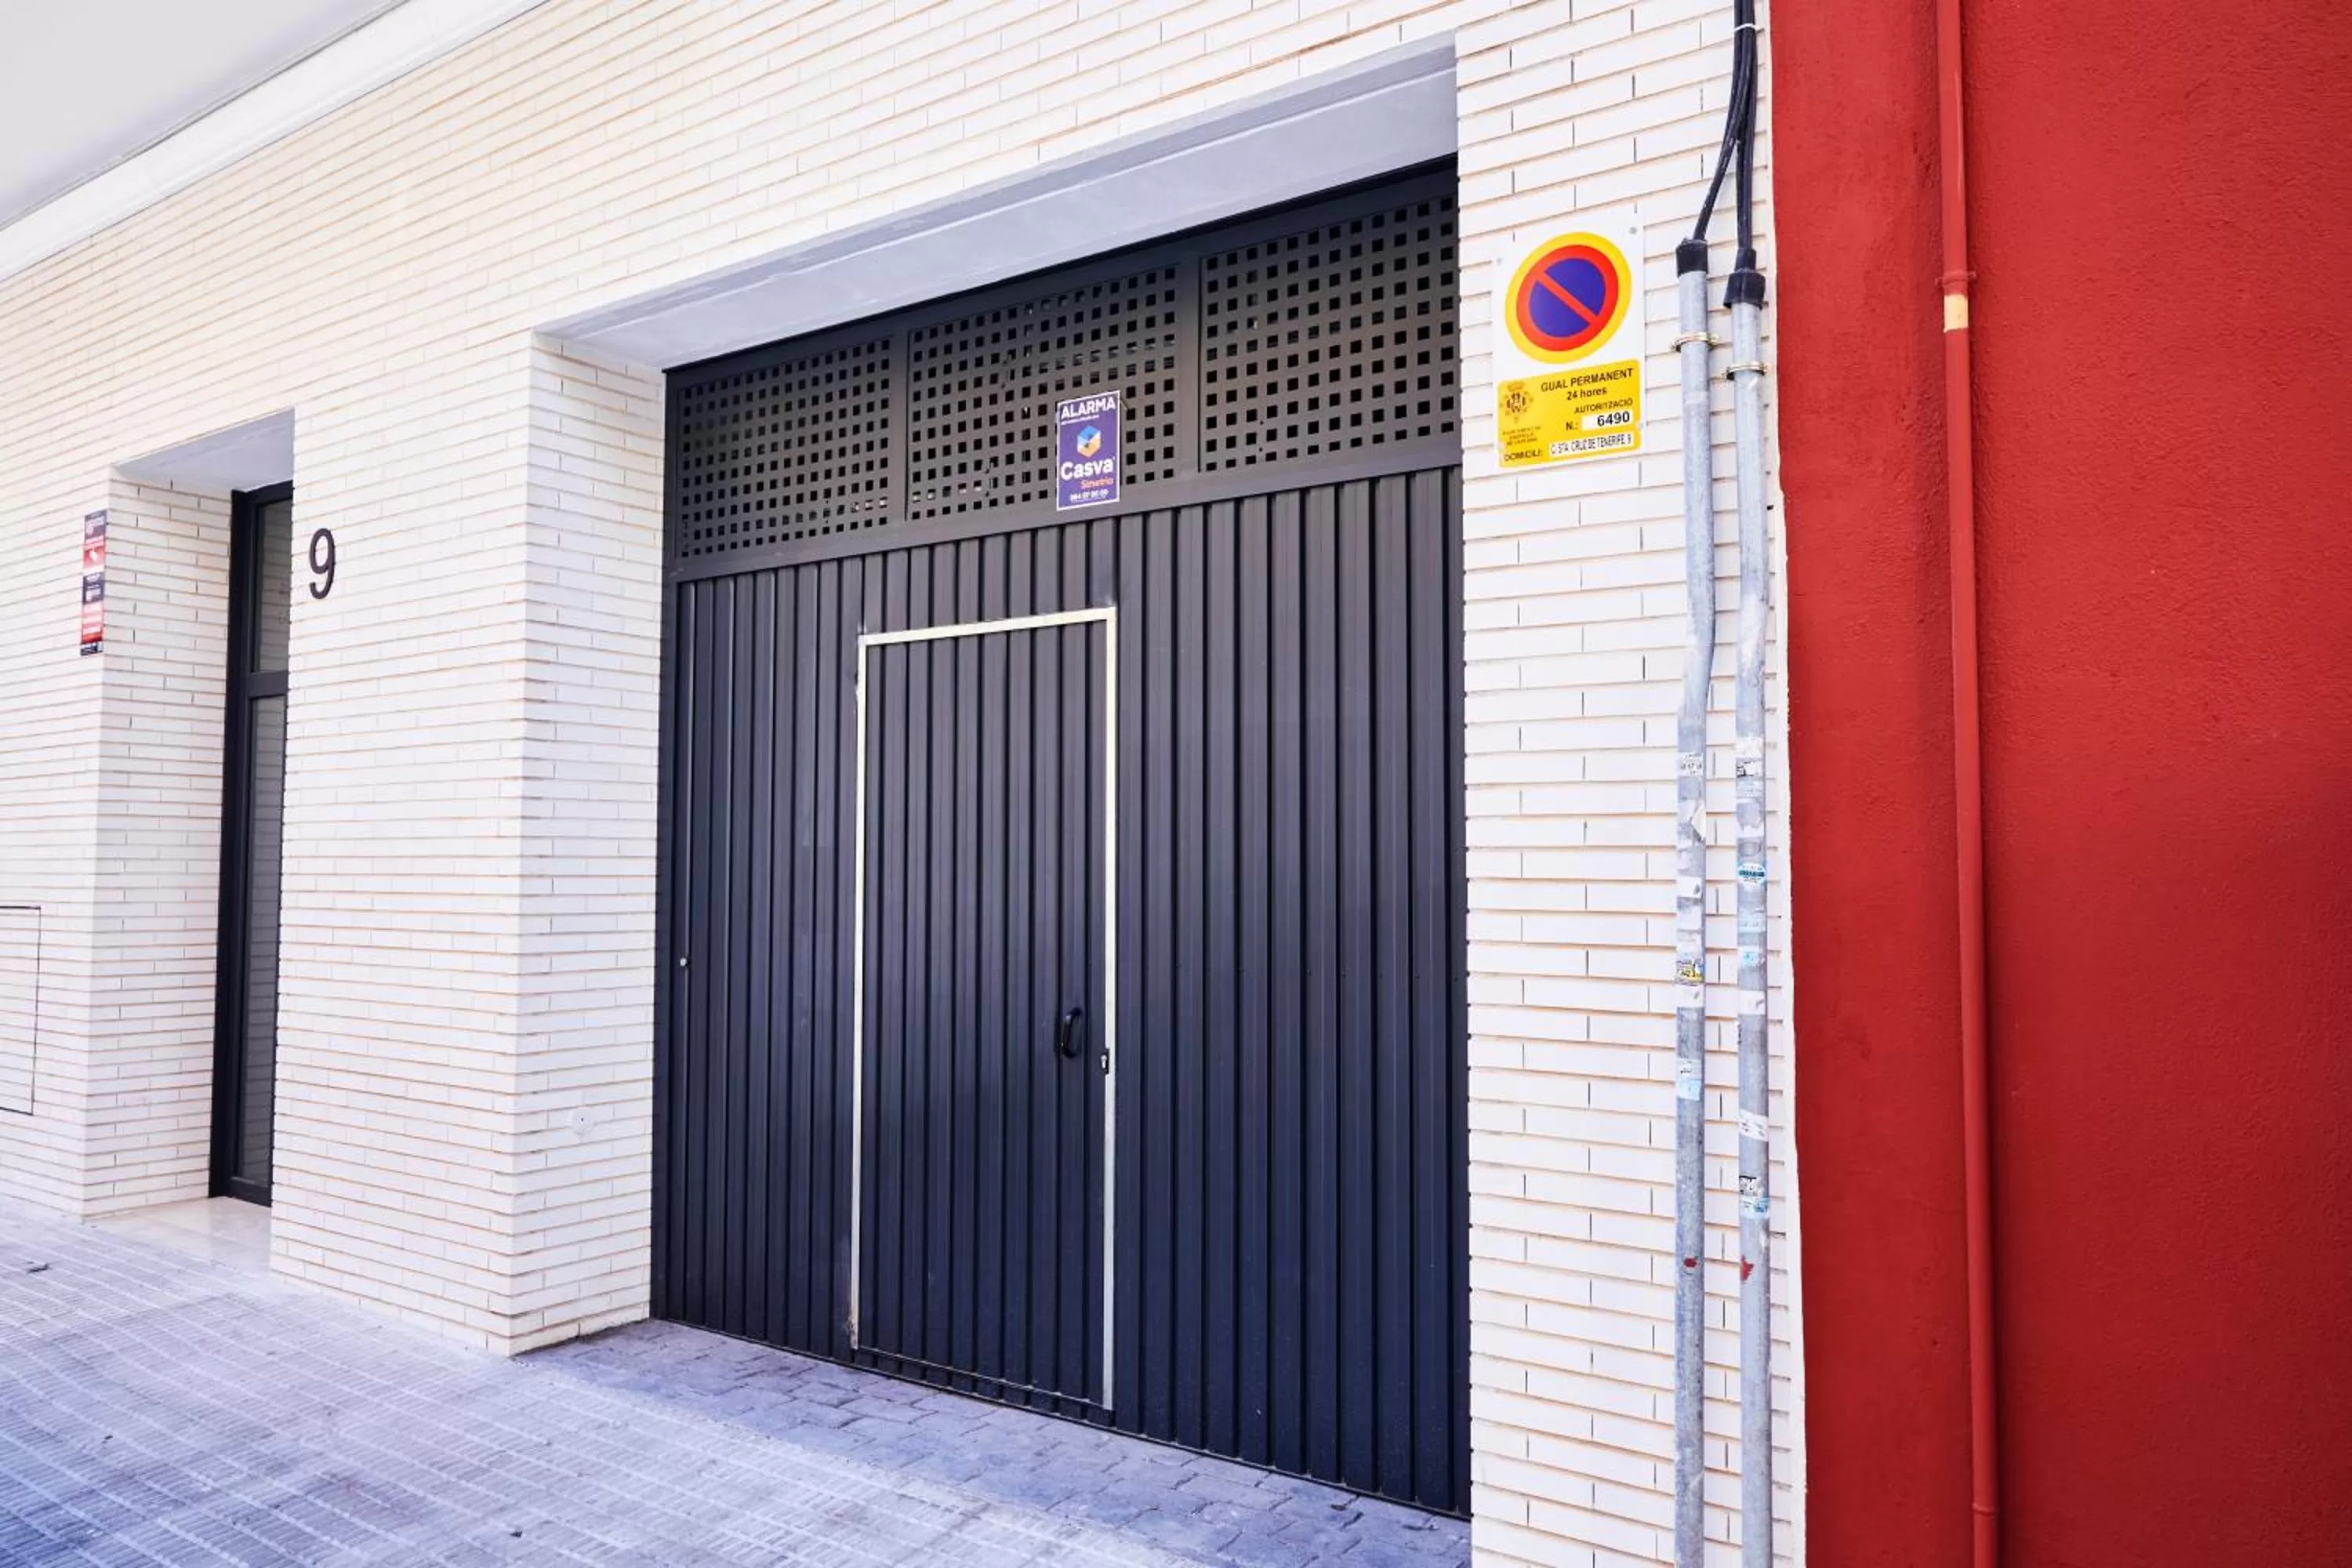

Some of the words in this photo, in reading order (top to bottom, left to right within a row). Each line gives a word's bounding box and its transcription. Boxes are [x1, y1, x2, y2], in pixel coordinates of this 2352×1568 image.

[1541, 380, 1568, 392] GUAL
[1570, 368, 1633, 387] PERMANENT
[1567, 390, 1578, 401] 24
[1581, 387, 1607, 398] hores
[1061, 397, 1116, 419] ALARMA
[1597, 411, 1630, 426] 6490
[1061, 459, 1113, 481] Casva
[309, 528, 336, 599] 9
